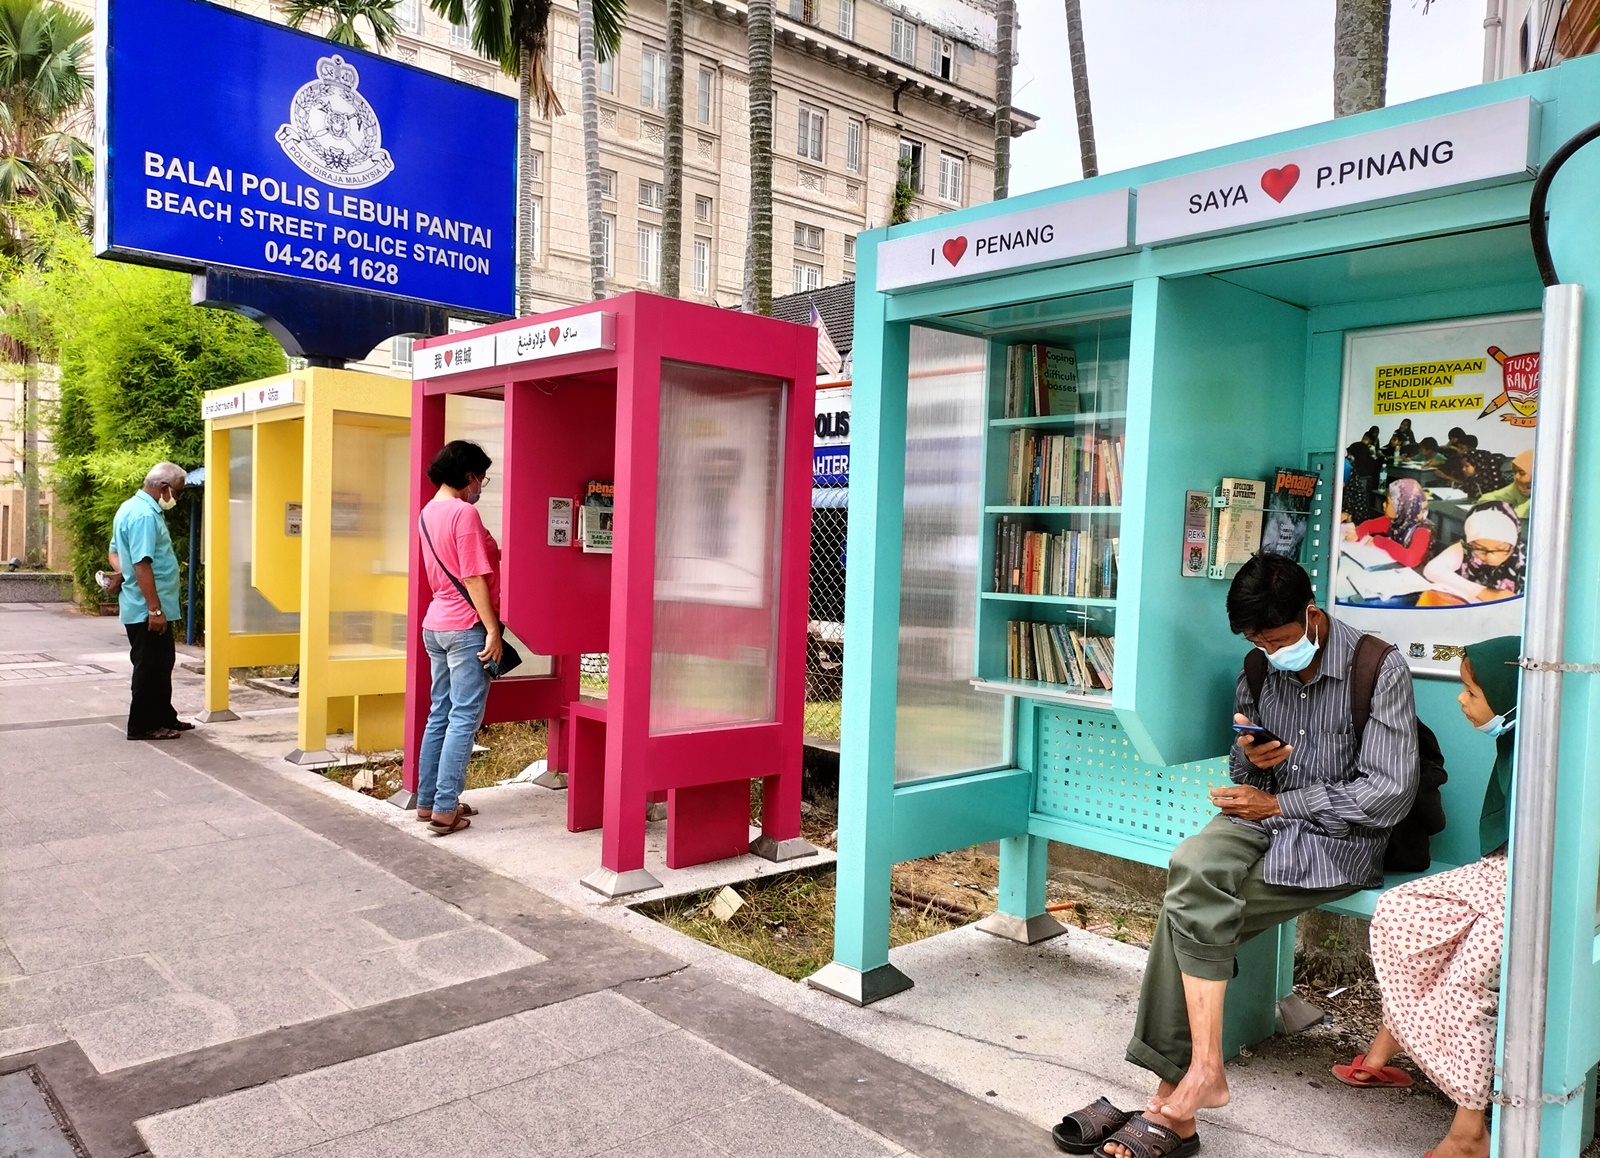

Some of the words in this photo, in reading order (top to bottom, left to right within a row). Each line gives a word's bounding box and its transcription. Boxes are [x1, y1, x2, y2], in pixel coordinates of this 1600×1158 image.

[290, 145, 312, 170] POLIS
[313, 166, 343, 184] DIRAJA
[345, 168, 382, 184] MALAYSIA
[1188, 184, 1249, 214] SAYA
[1316, 140, 1454, 189] P.PINANG
[144, 151, 233, 193] BALAI
[241, 172, 321, 211] POLIS
[327, 191, 409, 230] LEBUH
[415, 211, 492, 249] PANTAI
[146, 188, 232, 224] BEACH
[239, 207, 327, 242] STREET
[333, 226, 408, 259] POLICE
[413, 243, 490, 276] STATION
[931, 248, 935, 266] I
[975, 224, 1054, 257] PENANG
[264, 240, 342, 275] 04-264
[349, 256, 399, 285] 1628
[434, 353, 442, 370] 我
[1046, 350, 1075, 366] Coping
[1506, 356, 1539, 372] TUISY
[1043, 368, 1077, 382] difficult
[1378, 361, 1483, 378] PEMBERDAYAAN
[1047, 380, 1077, 393] bosses
[1378, 375, 1452, 389] PENDIDIKAN
[1506, 371, 1539, 391] RAKYA
[1377, 389, 1429, 401] MELALUI
[1377, 400, 1426, 412] TUISYEN
[1430, 397, 1483, 409] RAKYAT
[814, 411, 850, 438] OLIS
[587, 483, 614, 497] pena
[1275, 473, 1317, 497] penang
[1188, 530, 1206, 539] PEKA
